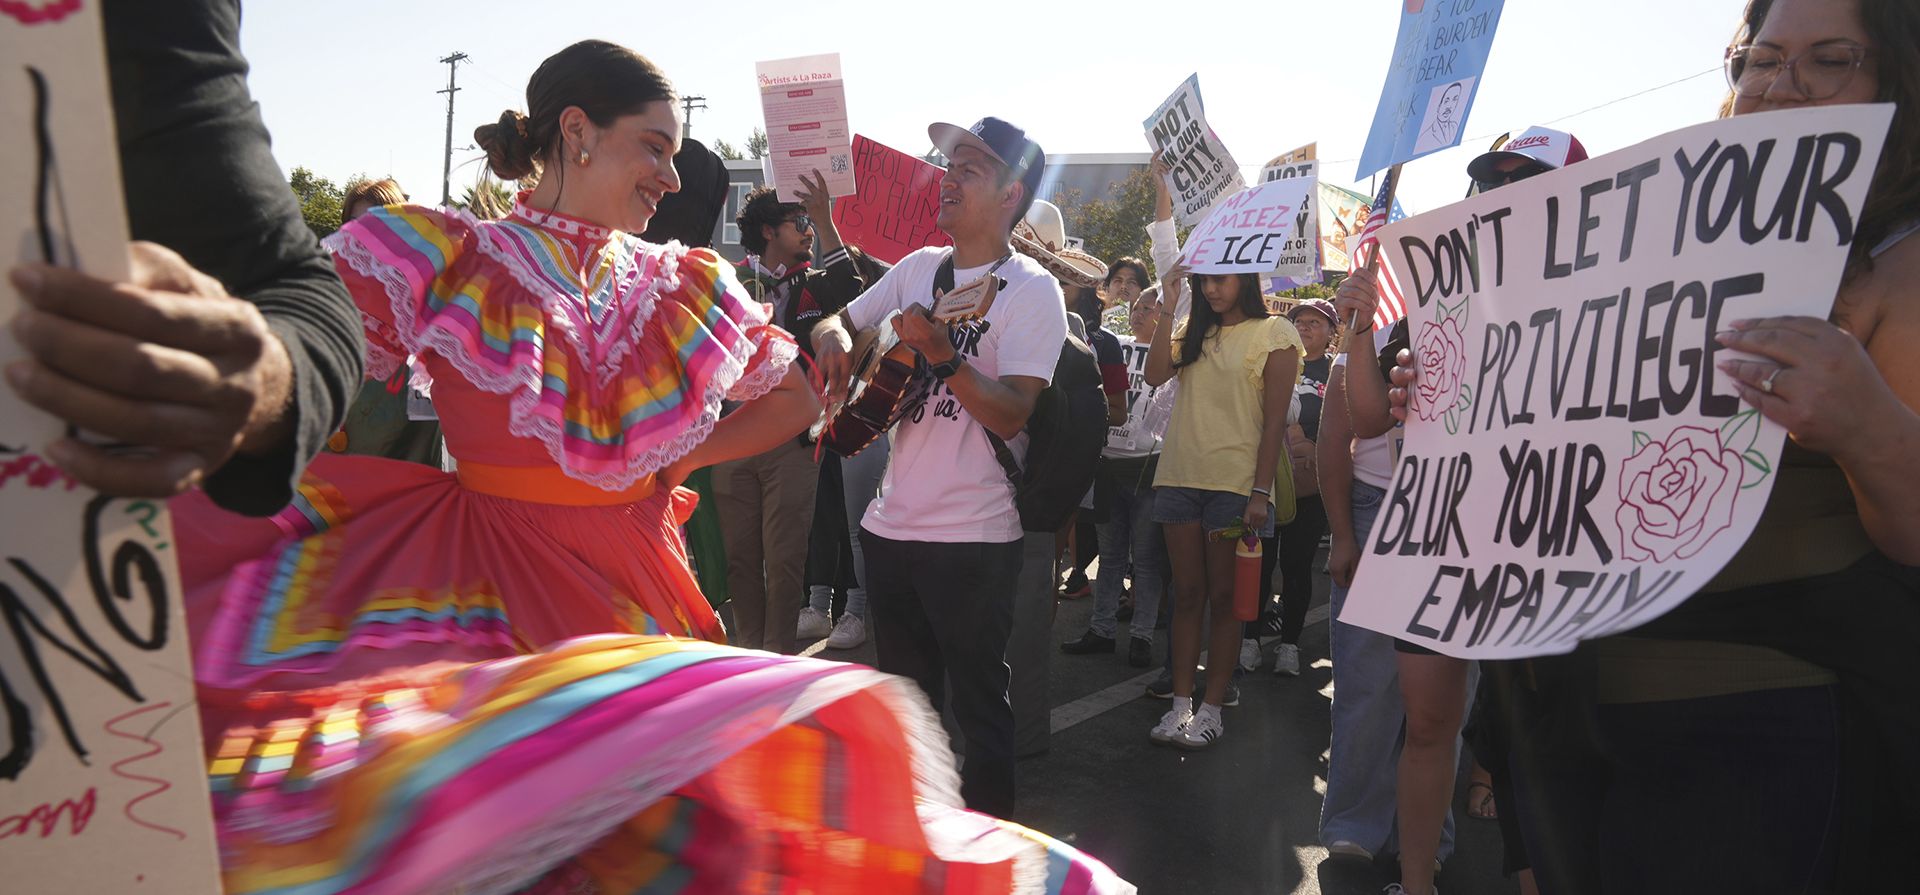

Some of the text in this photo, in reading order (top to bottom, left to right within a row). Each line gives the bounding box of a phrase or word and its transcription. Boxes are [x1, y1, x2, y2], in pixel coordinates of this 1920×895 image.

[1434, 10, 1494, 51] BURDEN
[800, 73, 810, 82] La
[811, 72, 832, 81] Raza
[1415, 49, 1458, 83] BEAR
[1152, 91, 1191, 149] NOT
[1162, 146, 1179, 170] IN
[1176, 119, 1202, 154] OUR
[1172, 135, 1216, 193] CITY
[1180, 158, 1225, 203] ICE OUT OF
[1186, 172, 1233, 216] California
[840, 199, 864, 228] IS
[1399, 131, 1863, 308] DON'T LET YOUR
[1214, 233, 1282, 266] ICE
[1295, 239, 1308, 250] OF
[1272, 300, 1293, 313] OUT
[1121, 344, 1149, 371] OT
[1468, 272, 1765, 435] PRIVILEGE
[1373, 439, 1613, 565] BLUR YOUR
